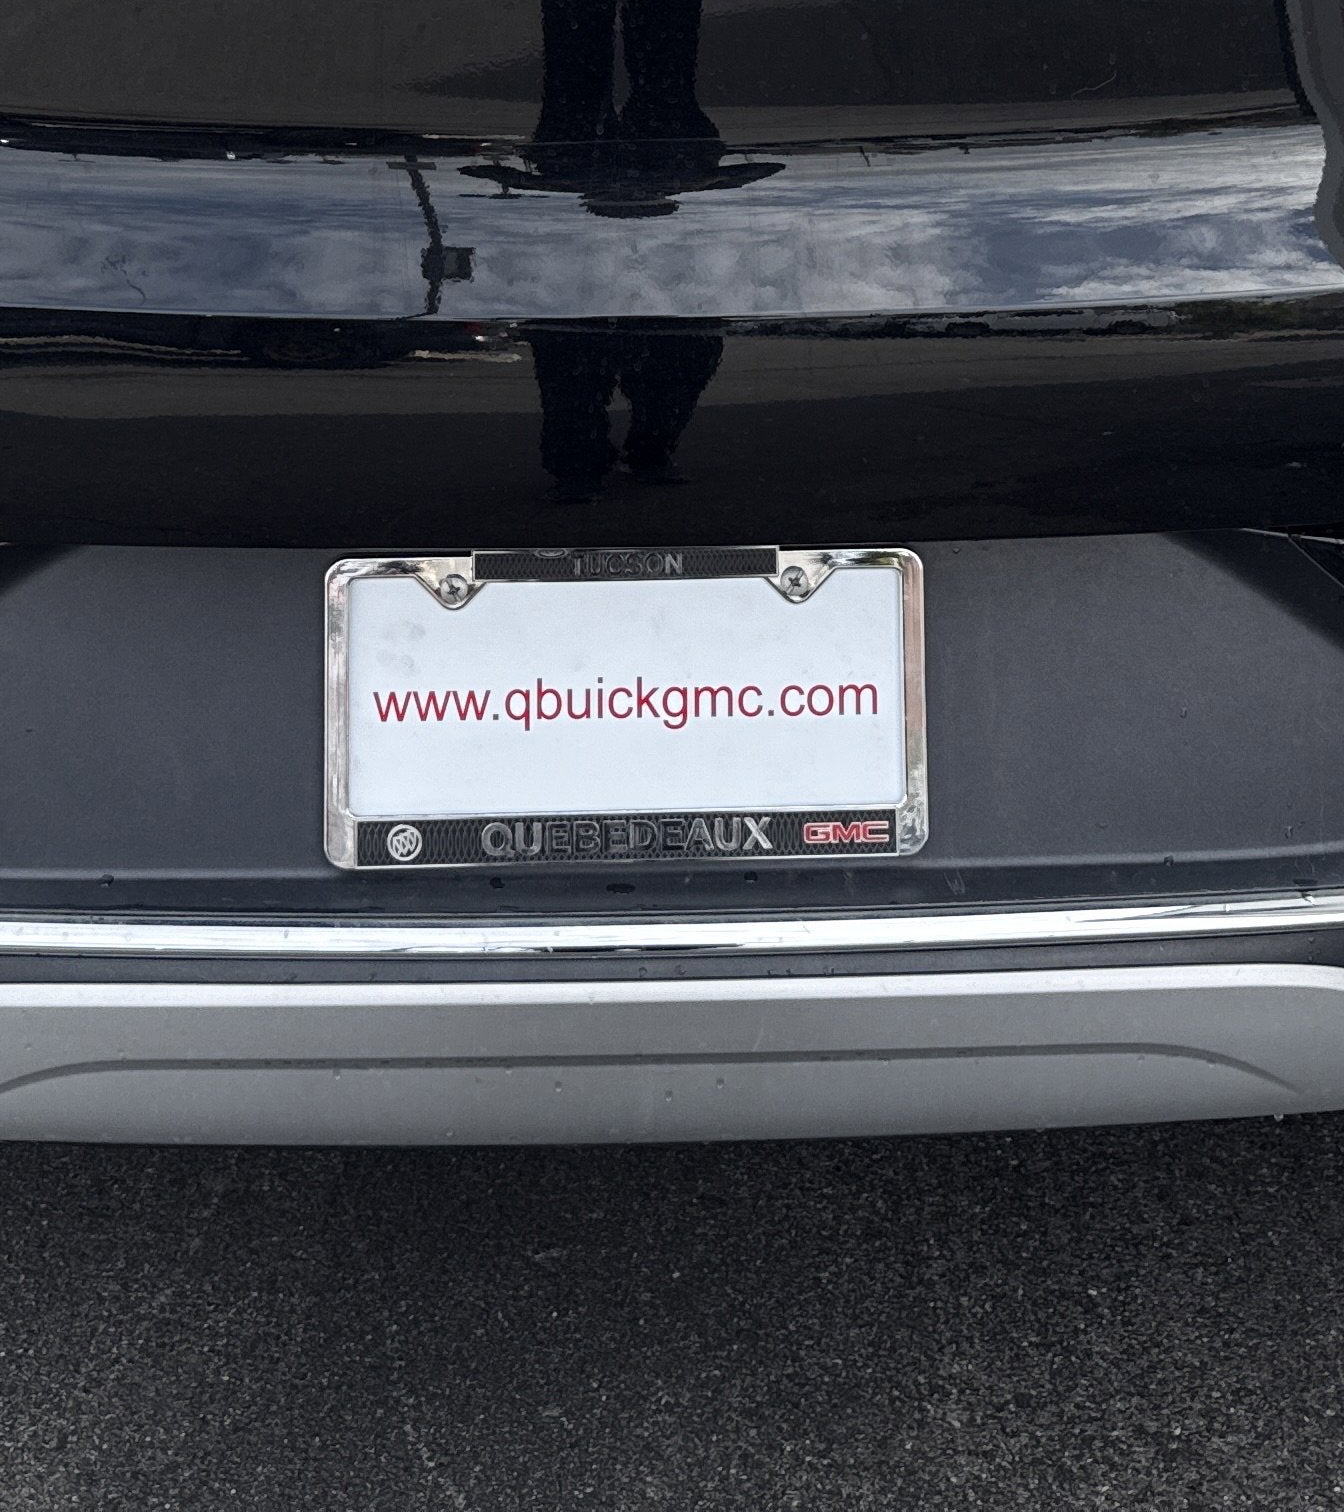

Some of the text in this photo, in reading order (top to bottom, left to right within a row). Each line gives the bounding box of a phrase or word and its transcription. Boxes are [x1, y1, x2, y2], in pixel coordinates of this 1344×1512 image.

[571, 550, 683, 576] TUCSON
[373, 677, 879, 731] www.qbuickgmc.com
[481, 816, 891, 856] QUEBEDEAUX GMC
